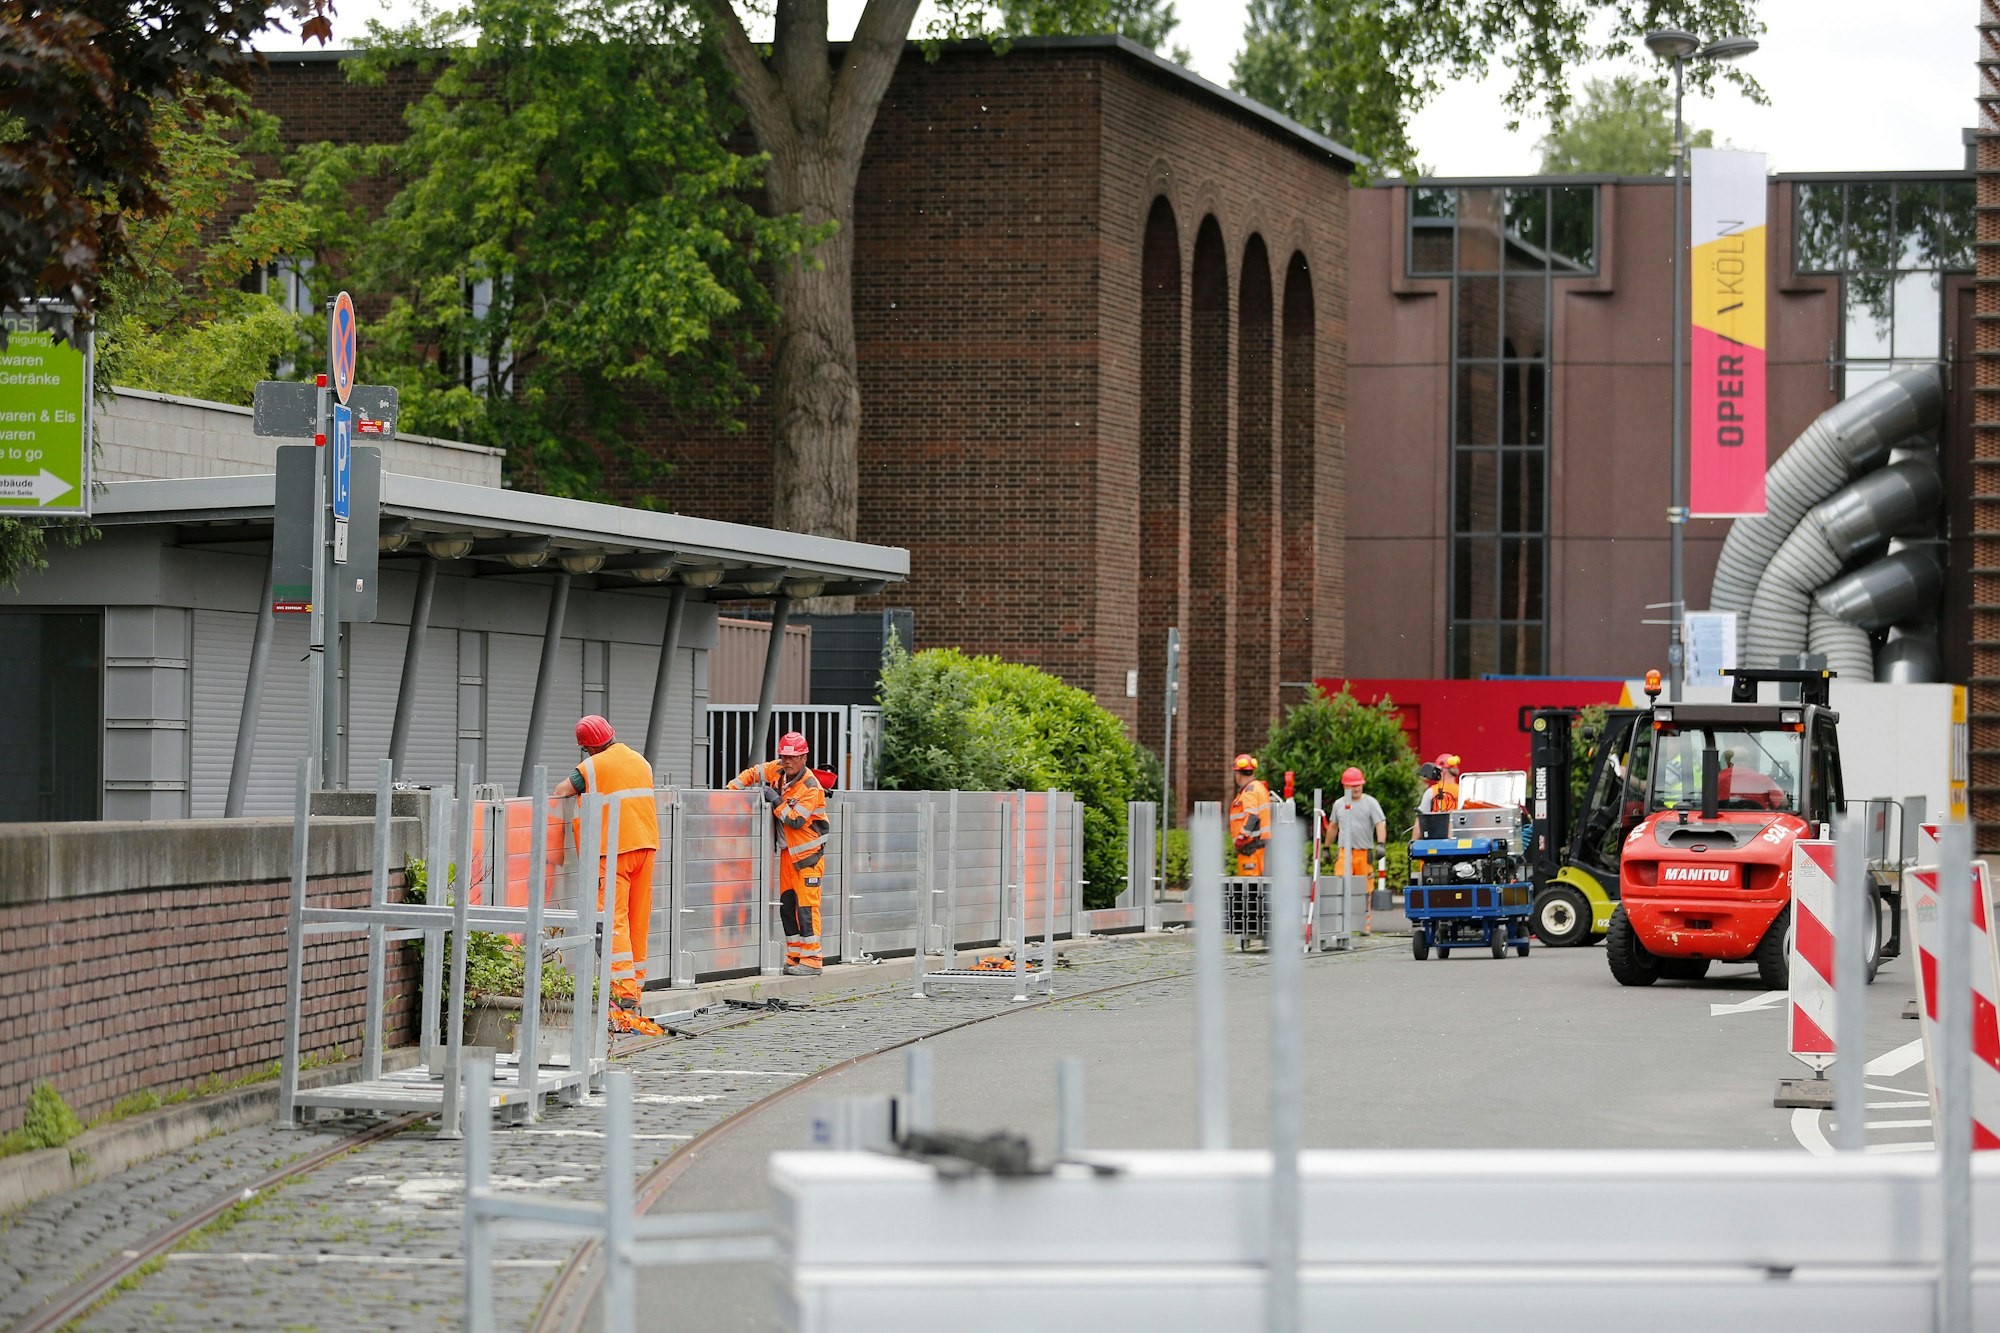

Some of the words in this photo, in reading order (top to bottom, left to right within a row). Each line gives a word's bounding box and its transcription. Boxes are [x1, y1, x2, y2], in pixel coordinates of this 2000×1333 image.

[1711, 220, 1744, 295] KÖLN
[0, 372, 60, 385] Getränke
[1717, 354, 1744, 448] OPER
[40, 410, 50, 422] &
[55, 410, 76, 423] Eis
[9, 447, 22, 459] to
[25, 449, 43, 462] go
[1536, 767, 1546, 799] CLARK
[1763, 824, 1791, 845] 924
[1664, 868, 1730, 882] MANITOU
